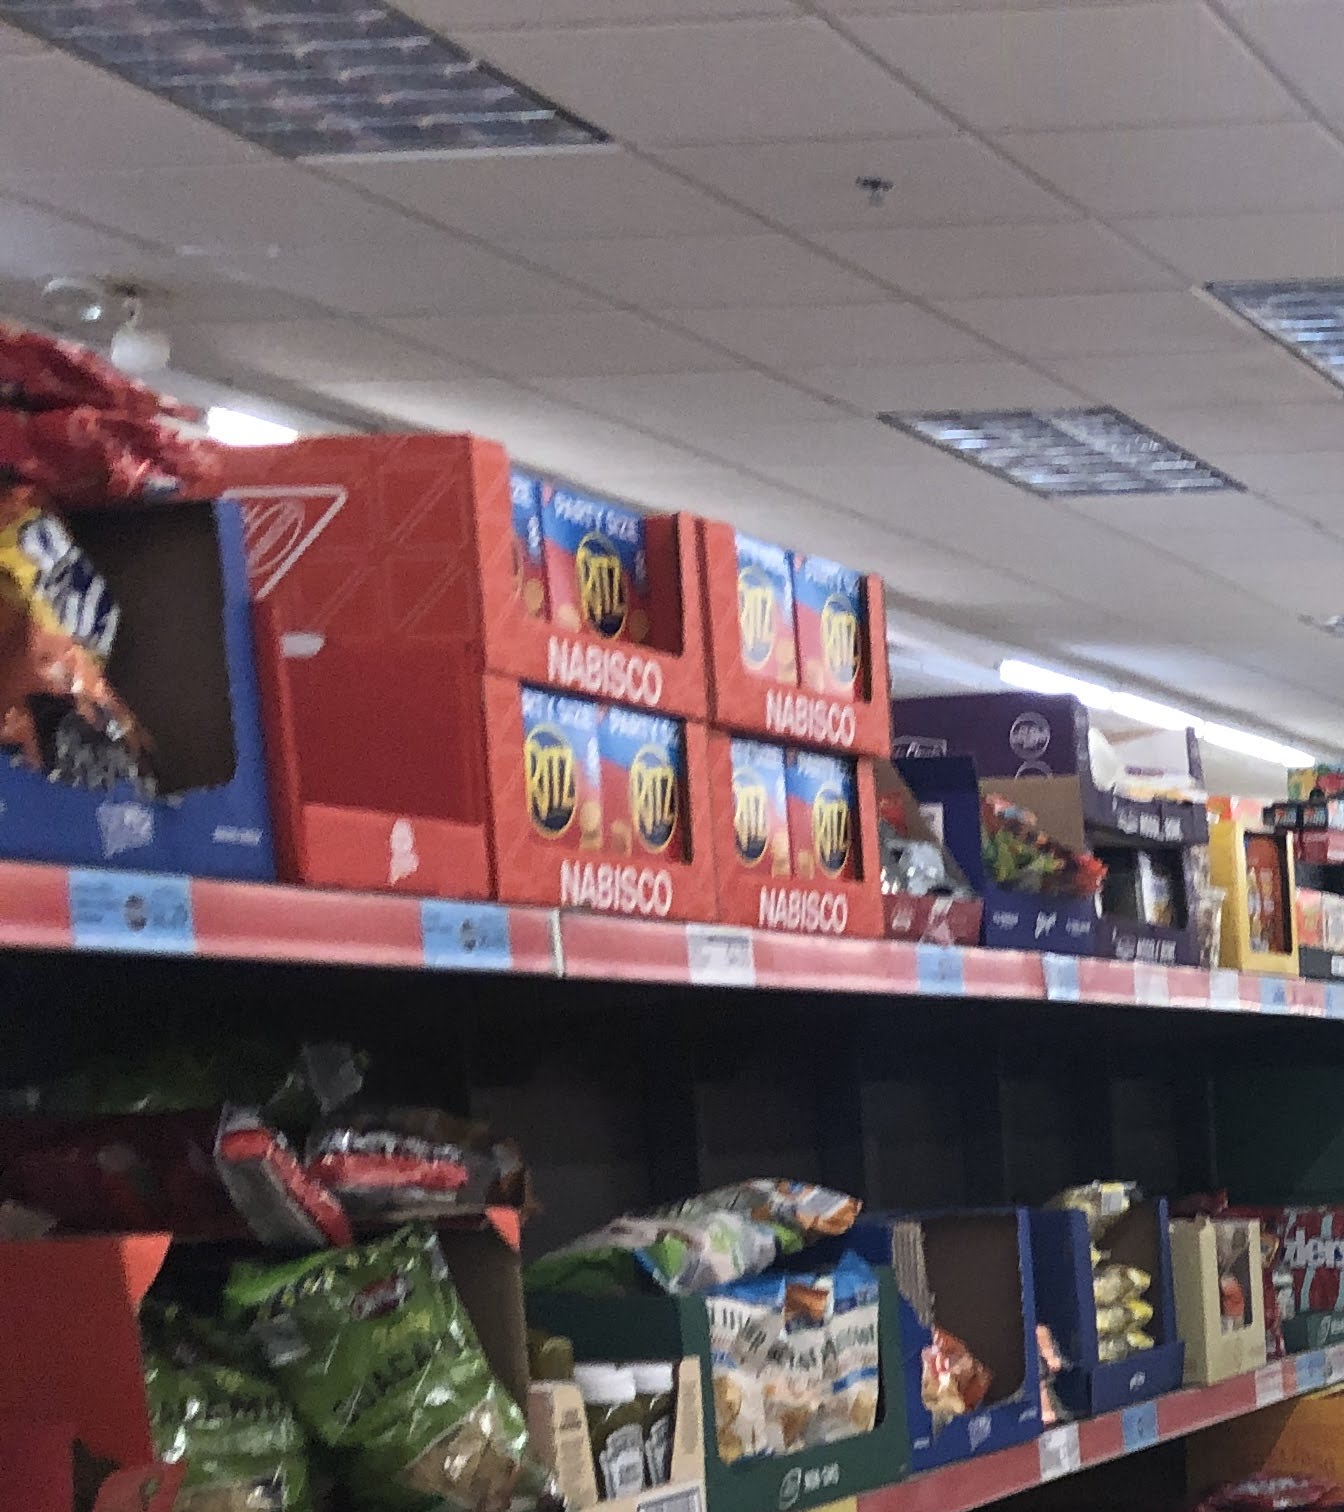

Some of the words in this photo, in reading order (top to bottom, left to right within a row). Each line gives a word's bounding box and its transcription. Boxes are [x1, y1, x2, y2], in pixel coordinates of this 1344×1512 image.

[547, 636, 663, 706] NABISCO
[765, 688, 856, 747] NABISCO
[526, 740, 576, 823] RITZ
[631, 762, 676, 836] RITZ
[561, 859, 673, 917] NABISCO
[759, 885, 848, 933] NABISCO
